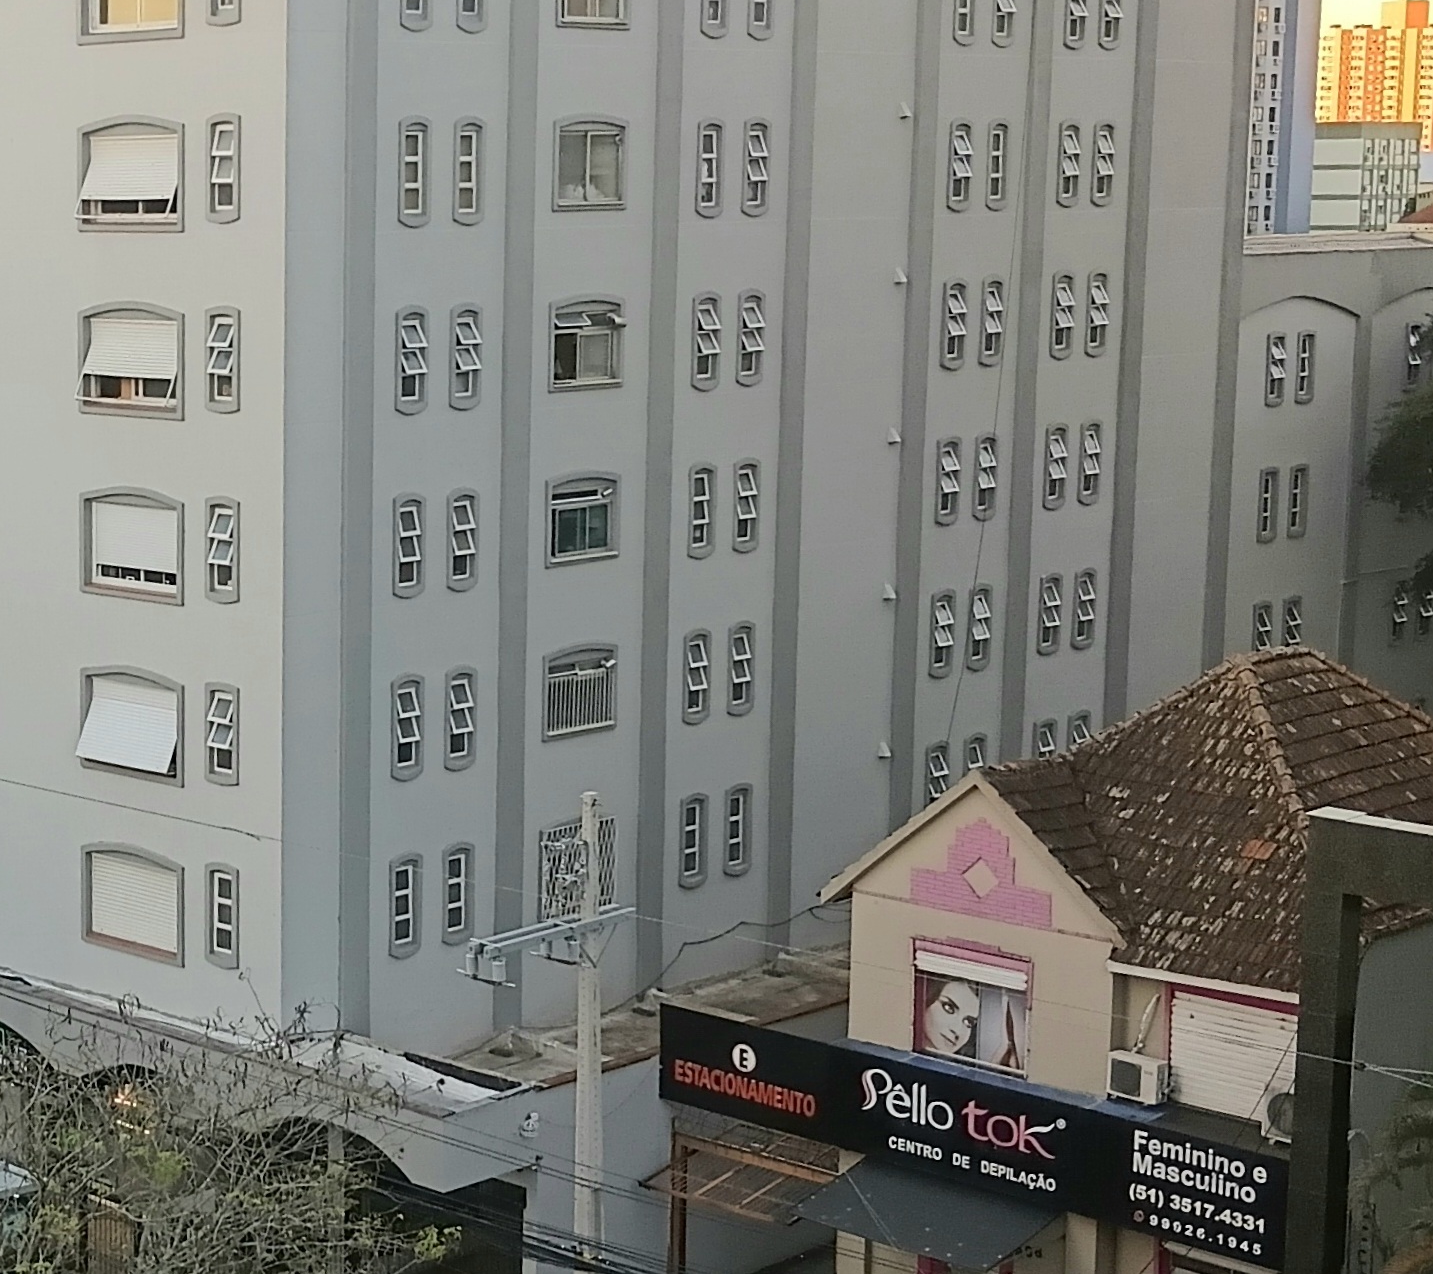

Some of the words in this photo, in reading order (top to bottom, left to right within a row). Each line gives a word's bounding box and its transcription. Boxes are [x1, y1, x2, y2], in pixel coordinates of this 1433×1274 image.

[739, 1048, 749, 1070] E
[674, 1058, 816, 1117] ESTACIONAMENTO
[860, 1068, 954, 1130] Pêllo
[888, 1135, 942, 1161] CENTRO
[952, 1152, 970, 1169] DE
[980, 1159, 1057, 1192] DEPILAÇÃO
[1132, 1151, 1257, 1203] Masculino
[1133, 1129, 1246, 1178] Feminino
[1252, 1166, 1268, 1184] e
[1128, 1183, 1165, 1209] (51)
[1169, 1194, 1266, 1234] 3517.4331
